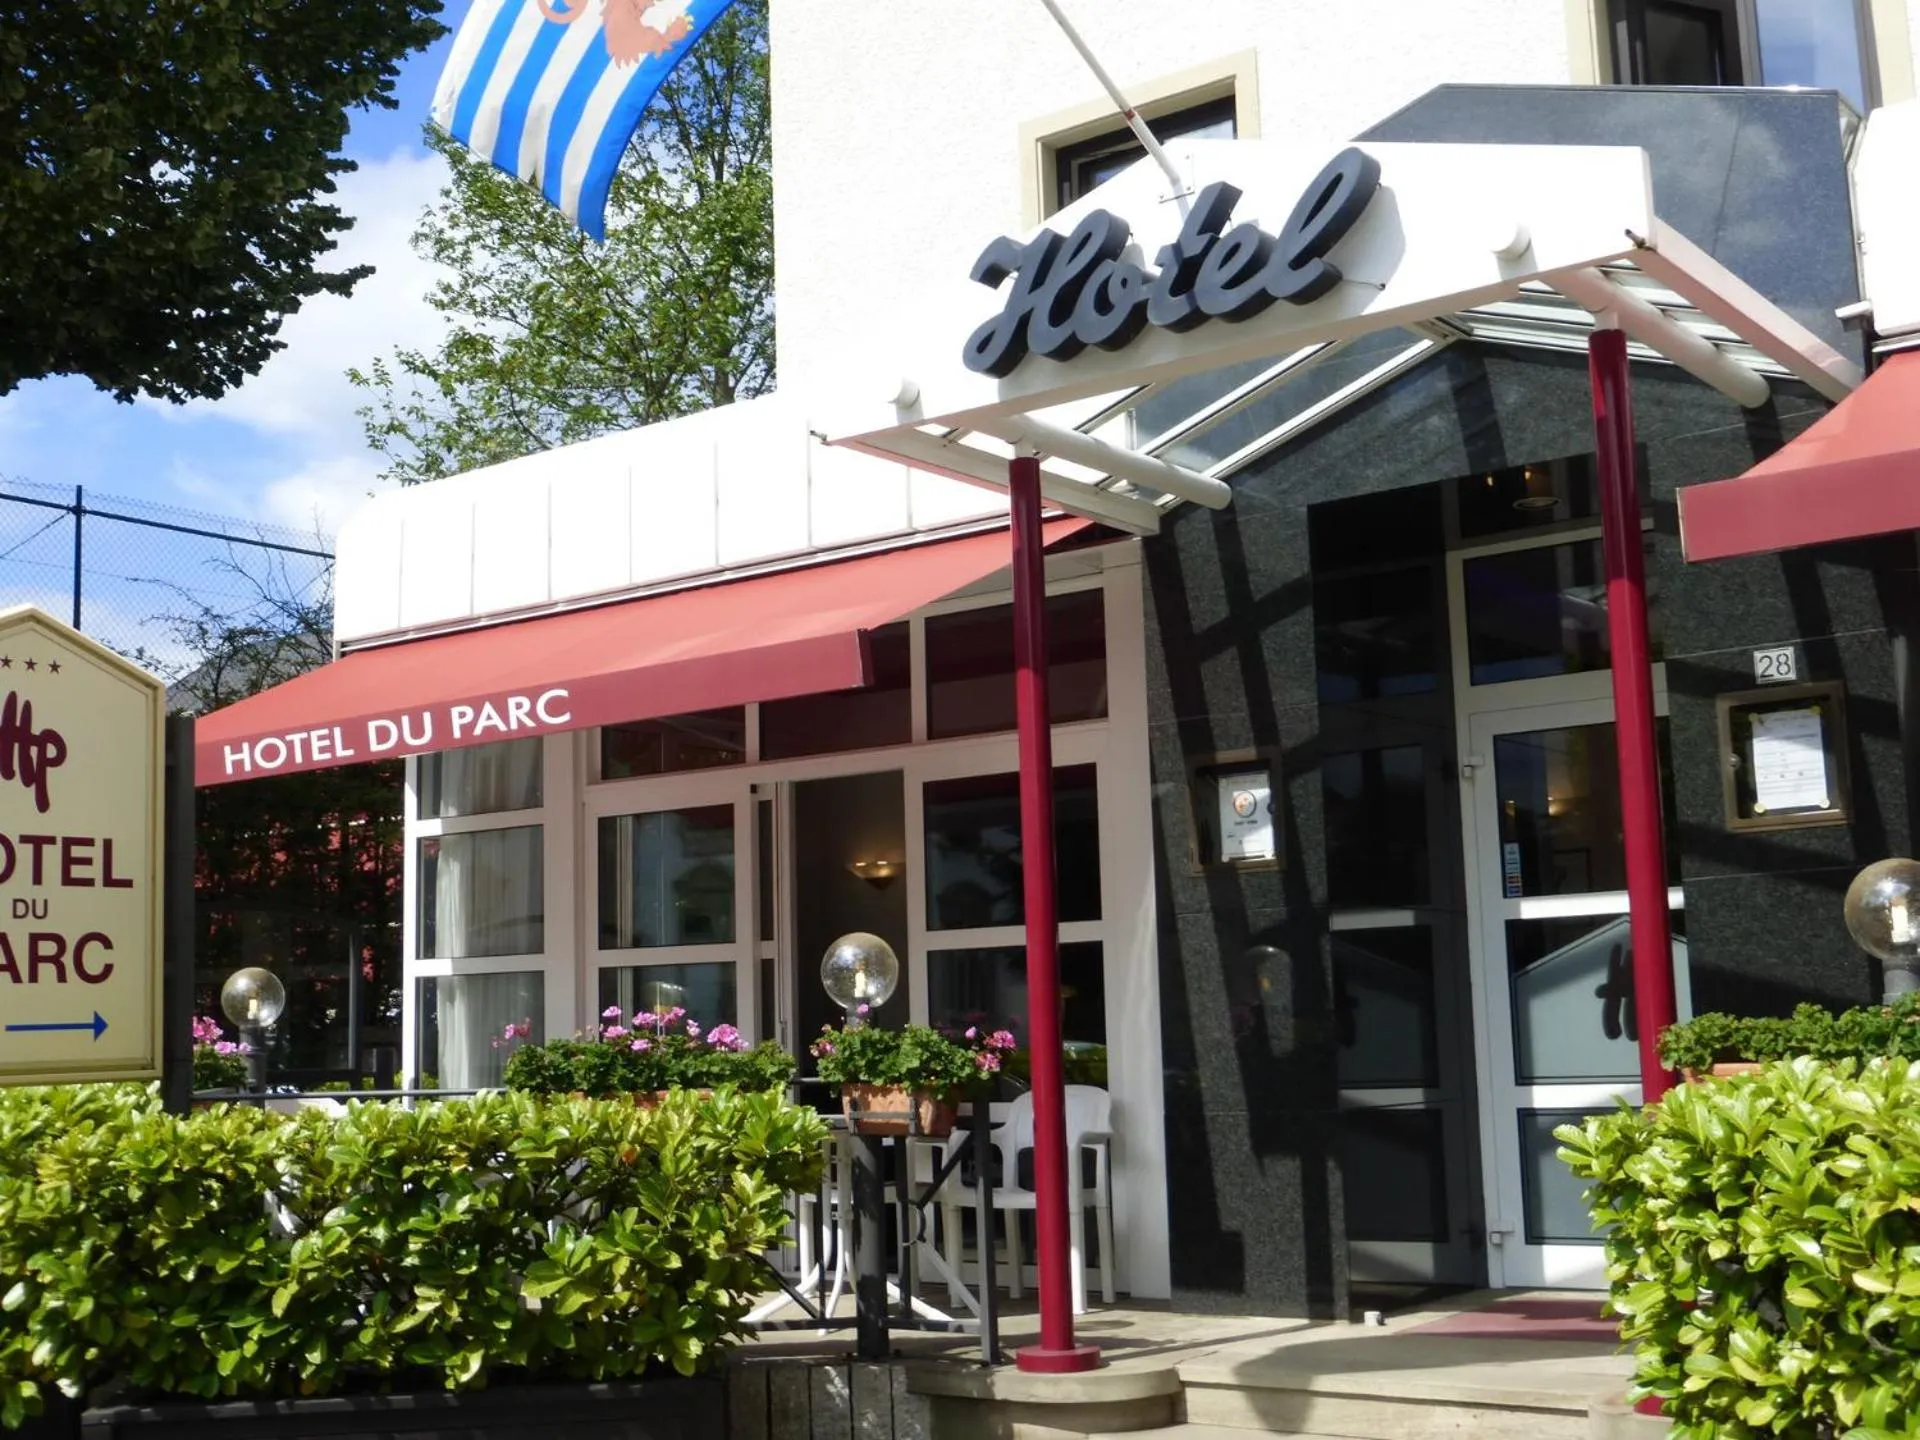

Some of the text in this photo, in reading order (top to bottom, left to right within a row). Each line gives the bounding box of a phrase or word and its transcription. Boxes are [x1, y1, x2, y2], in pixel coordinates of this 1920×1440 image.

[962, 146, 1382, 379] Hotel
[1758, 653, 1791, 678] 28
[223, 688, 571, 775] HOTEL DU PARC
[12, 898, 48, 920] DU
